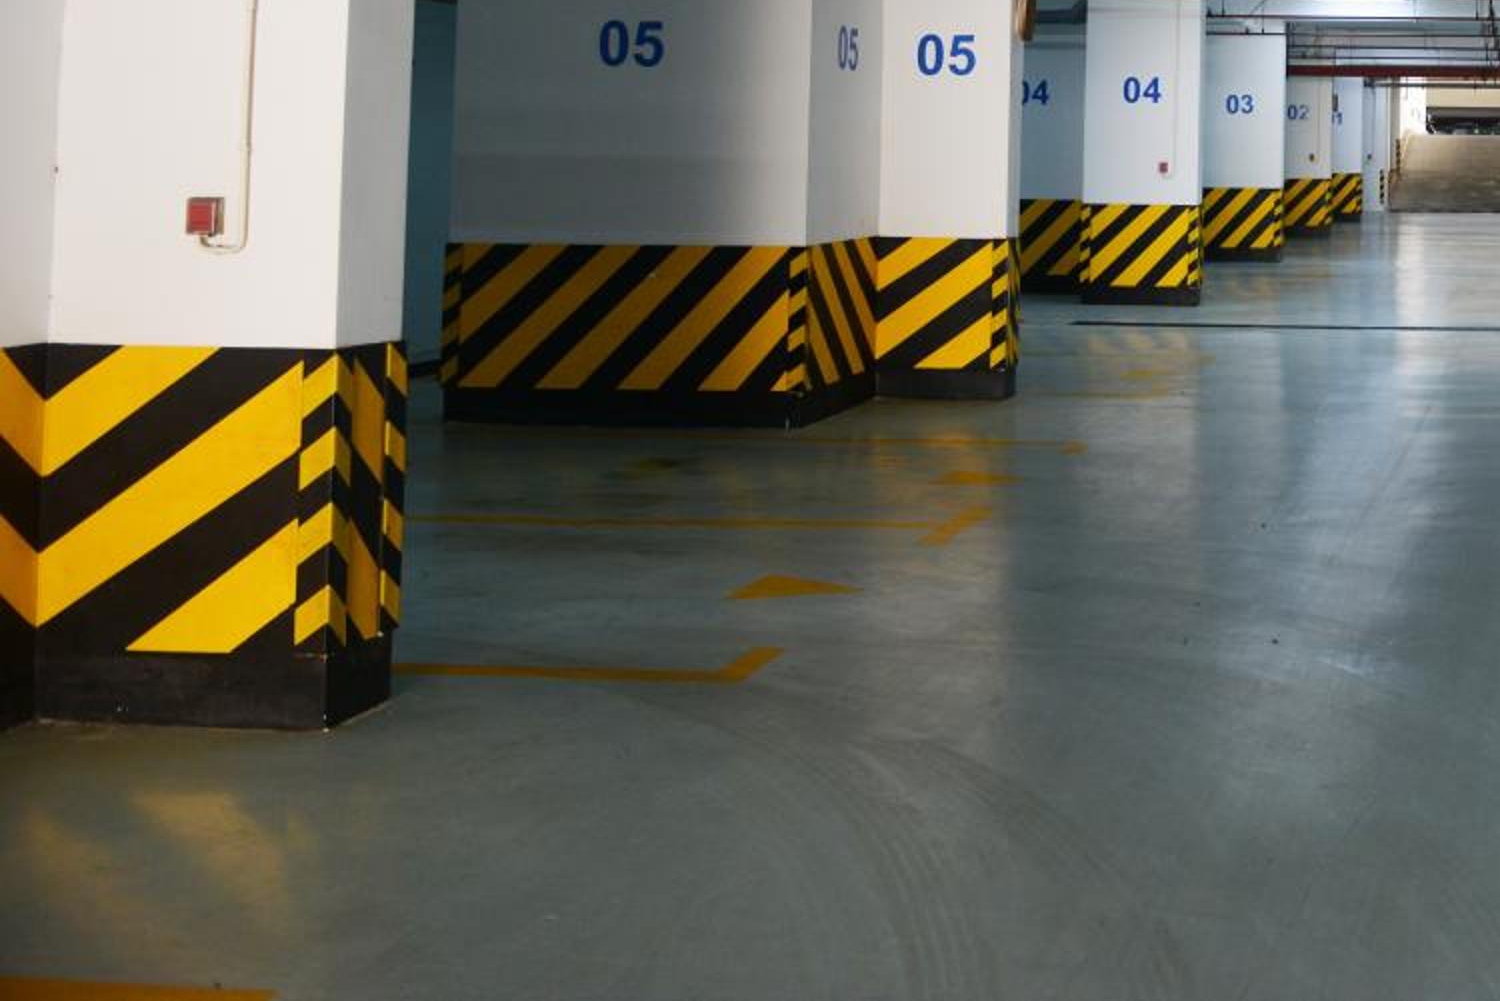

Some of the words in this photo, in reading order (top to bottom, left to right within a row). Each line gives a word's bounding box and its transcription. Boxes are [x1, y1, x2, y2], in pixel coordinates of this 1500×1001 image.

[599, 20, 664, 67] 05
[837, 25, 859, 71] 05
[917, 33, 976, 76] 05
[1123, 76, 1162, 104] 04
[1225, 94, 1254, 115] 03
[1287, 104, 1309, 120] 02
